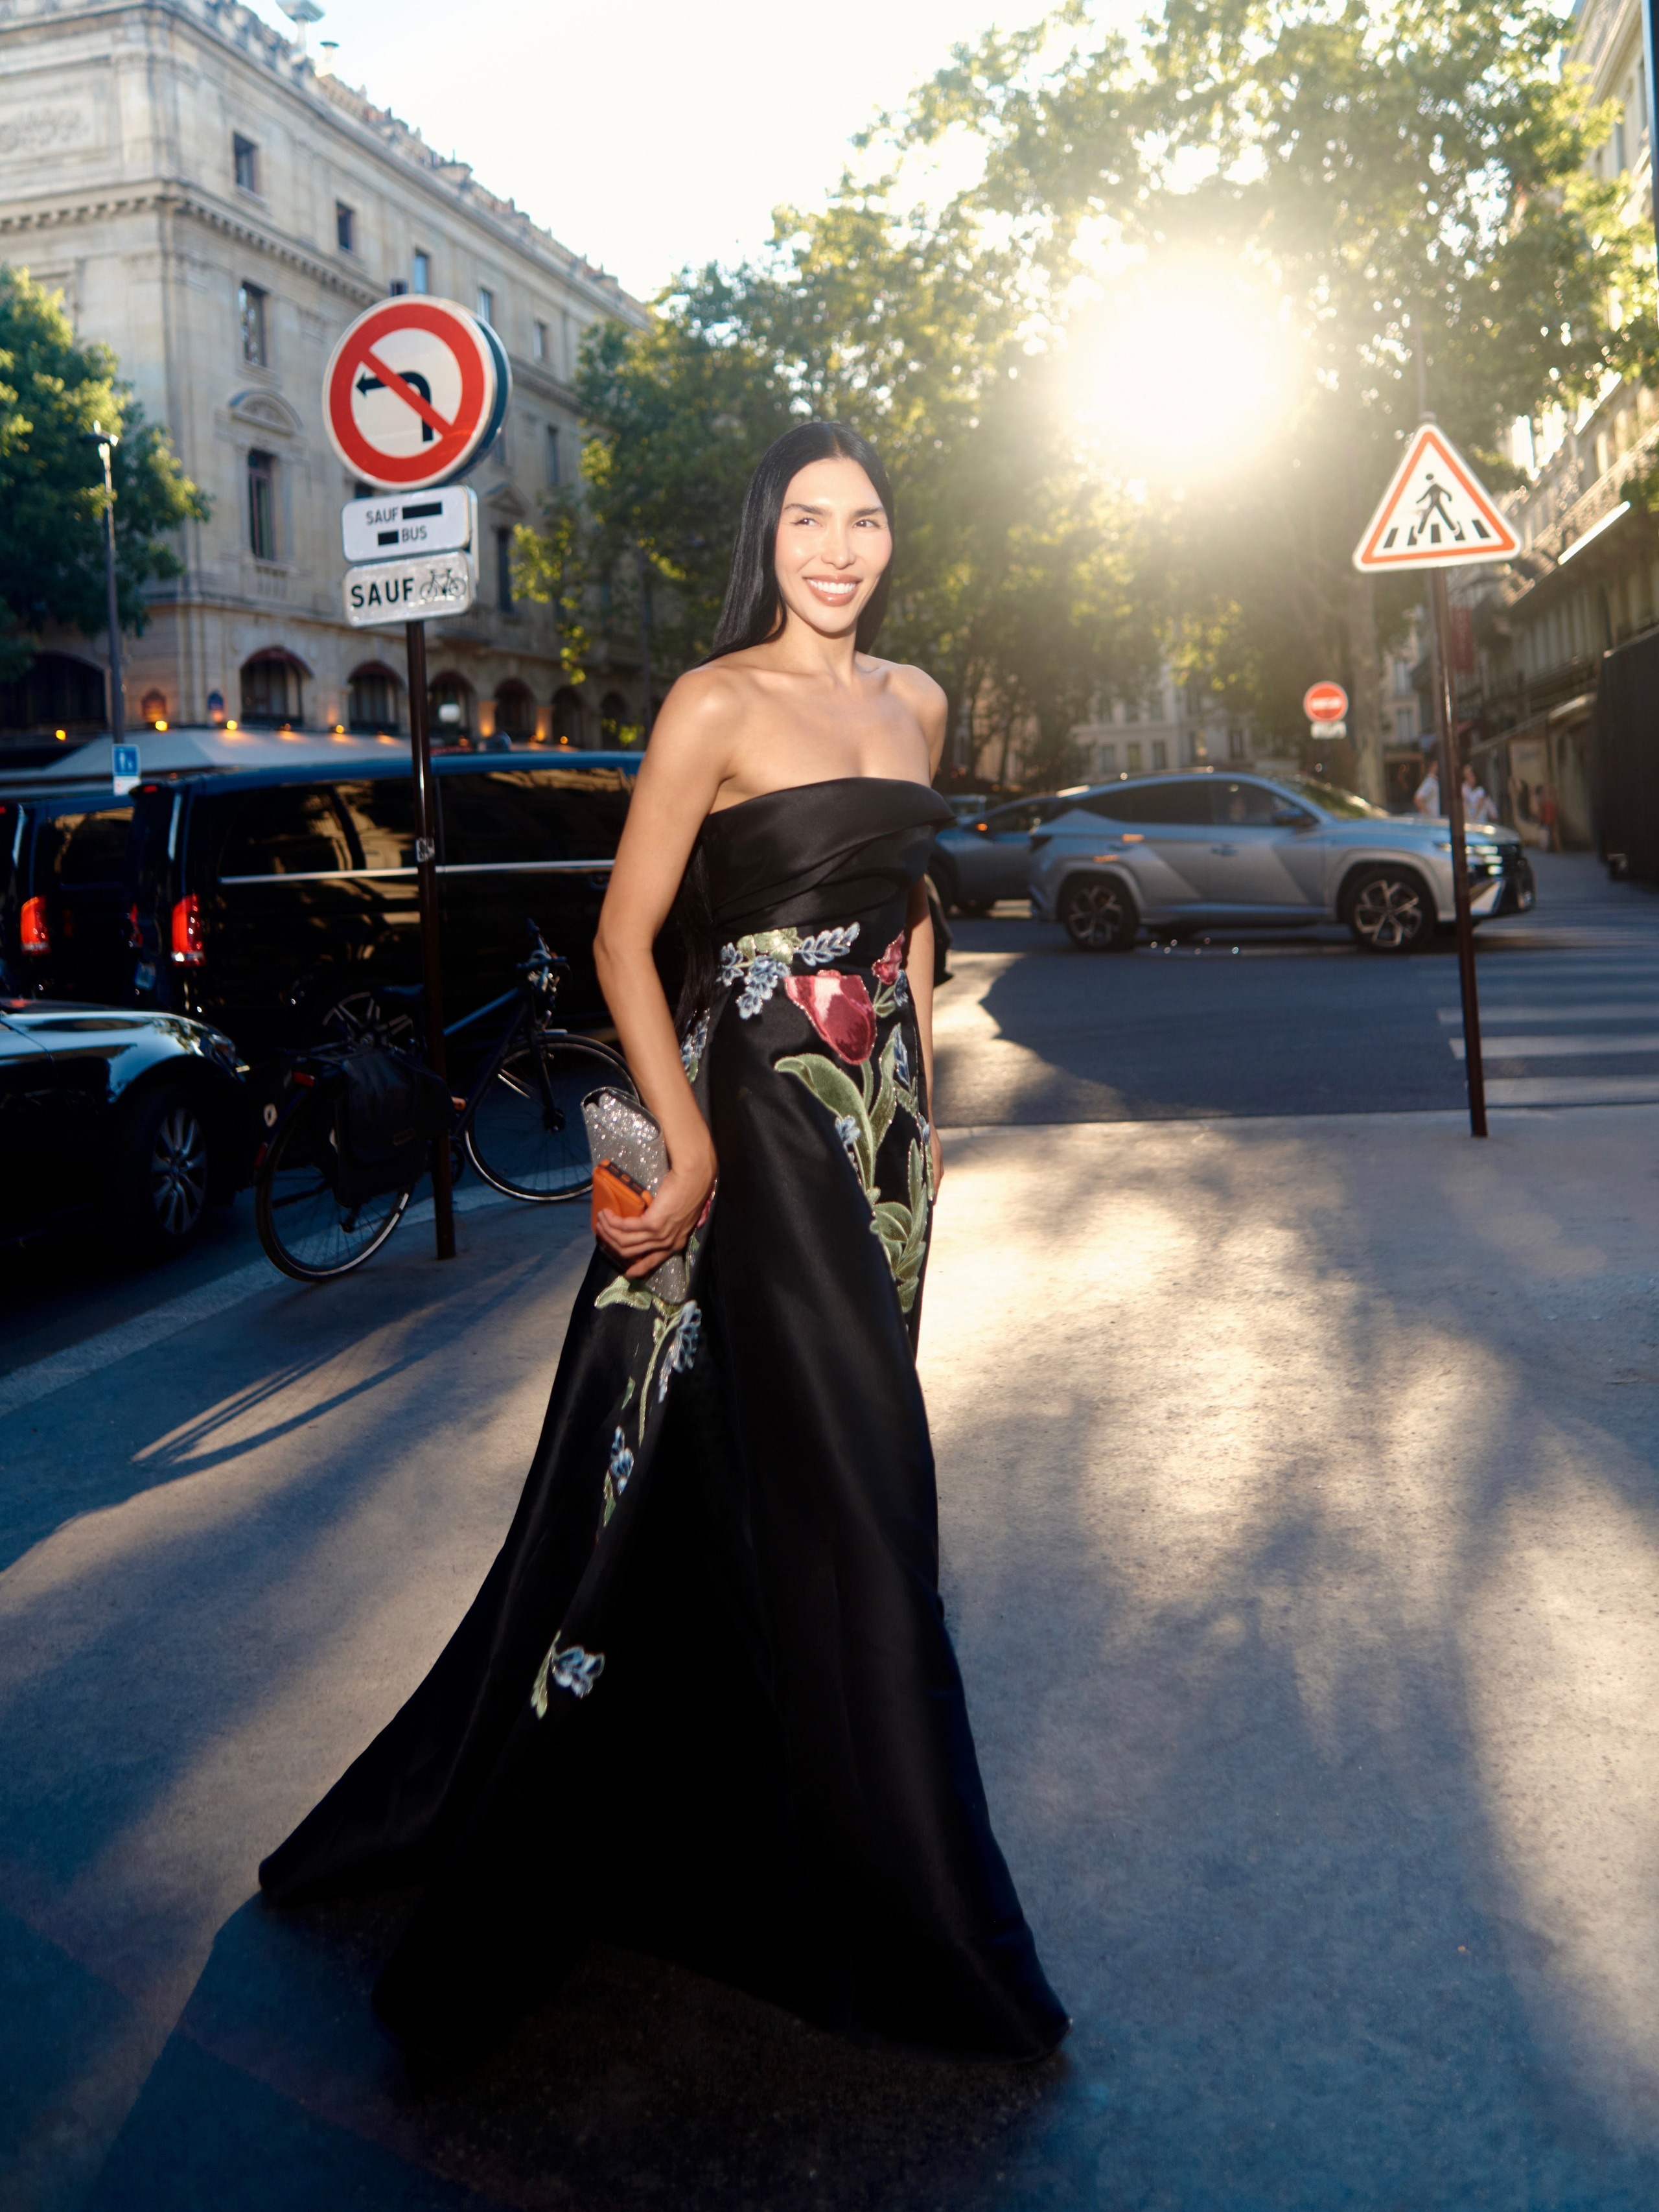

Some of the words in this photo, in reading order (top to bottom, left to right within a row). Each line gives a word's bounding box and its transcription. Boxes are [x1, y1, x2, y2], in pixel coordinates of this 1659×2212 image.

[366, 507, 399, 524] SAUF
[402, 526, 427, 542] BUS
[351, 578, 413, 607] SAUF
